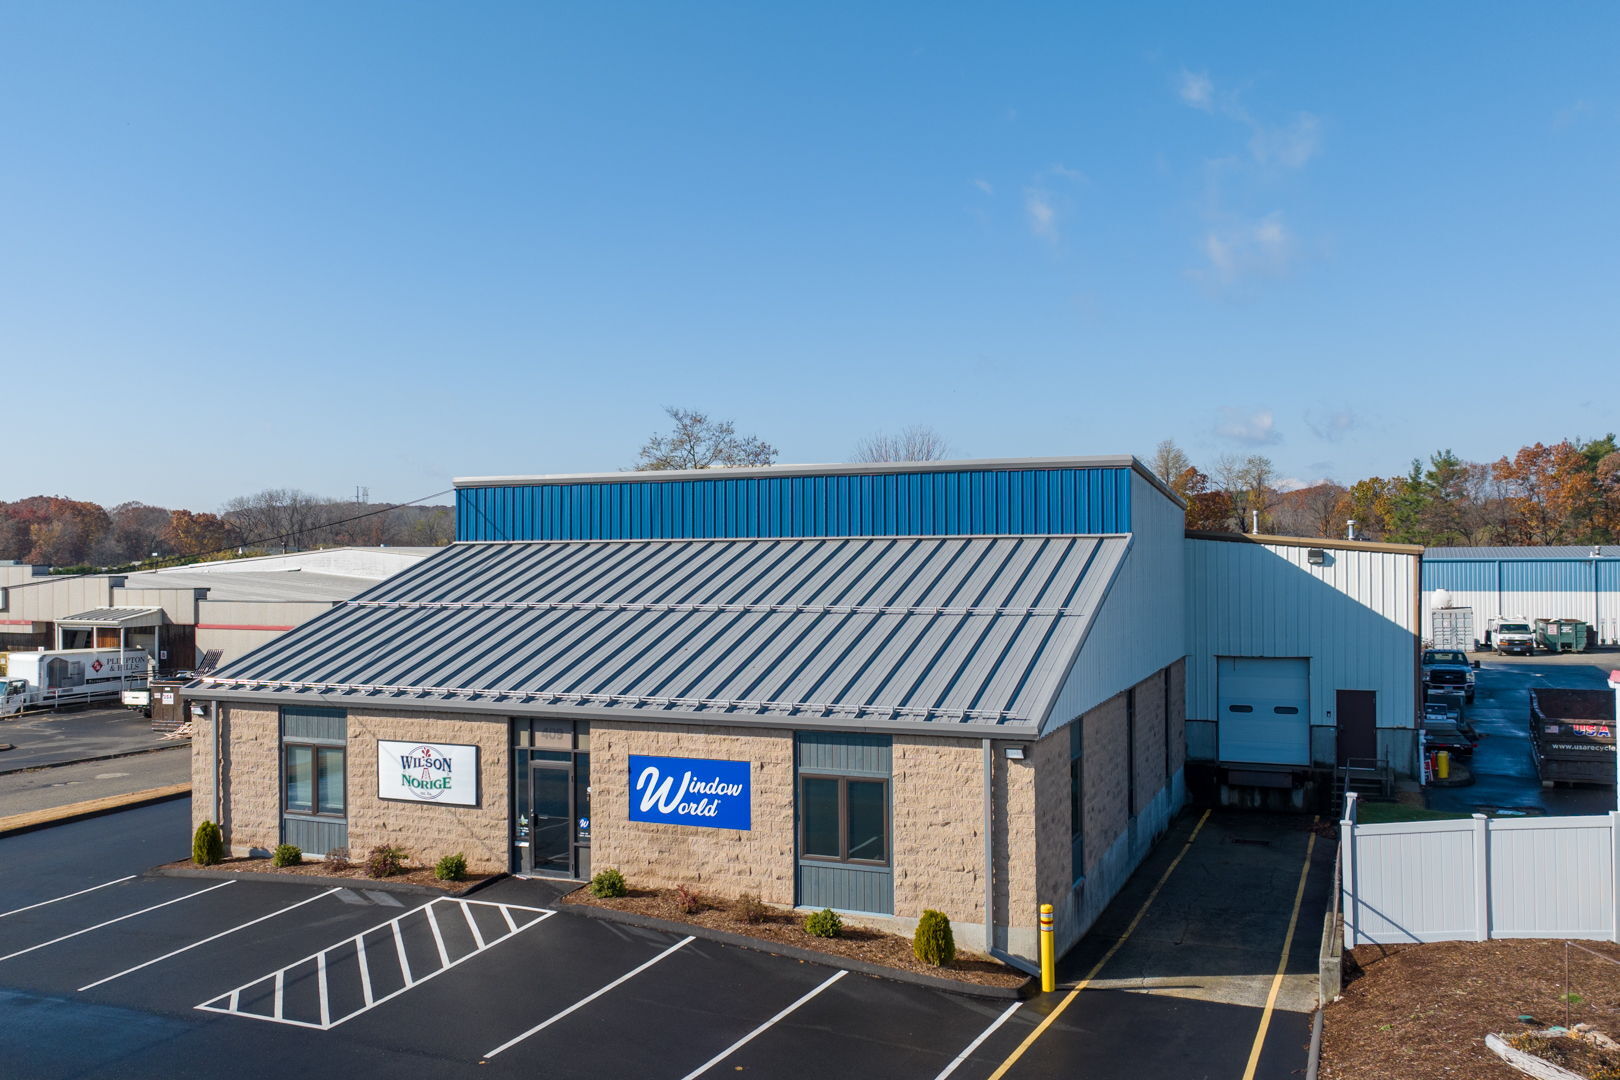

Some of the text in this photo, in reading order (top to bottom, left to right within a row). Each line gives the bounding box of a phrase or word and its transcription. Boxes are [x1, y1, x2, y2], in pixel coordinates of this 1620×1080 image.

[1573, 724, 1610, 737] USA
[400, 755, 452, 773] WILSON
[401, 773, 452, 790] NORIGE
[636, 766, 743, 814] Window
